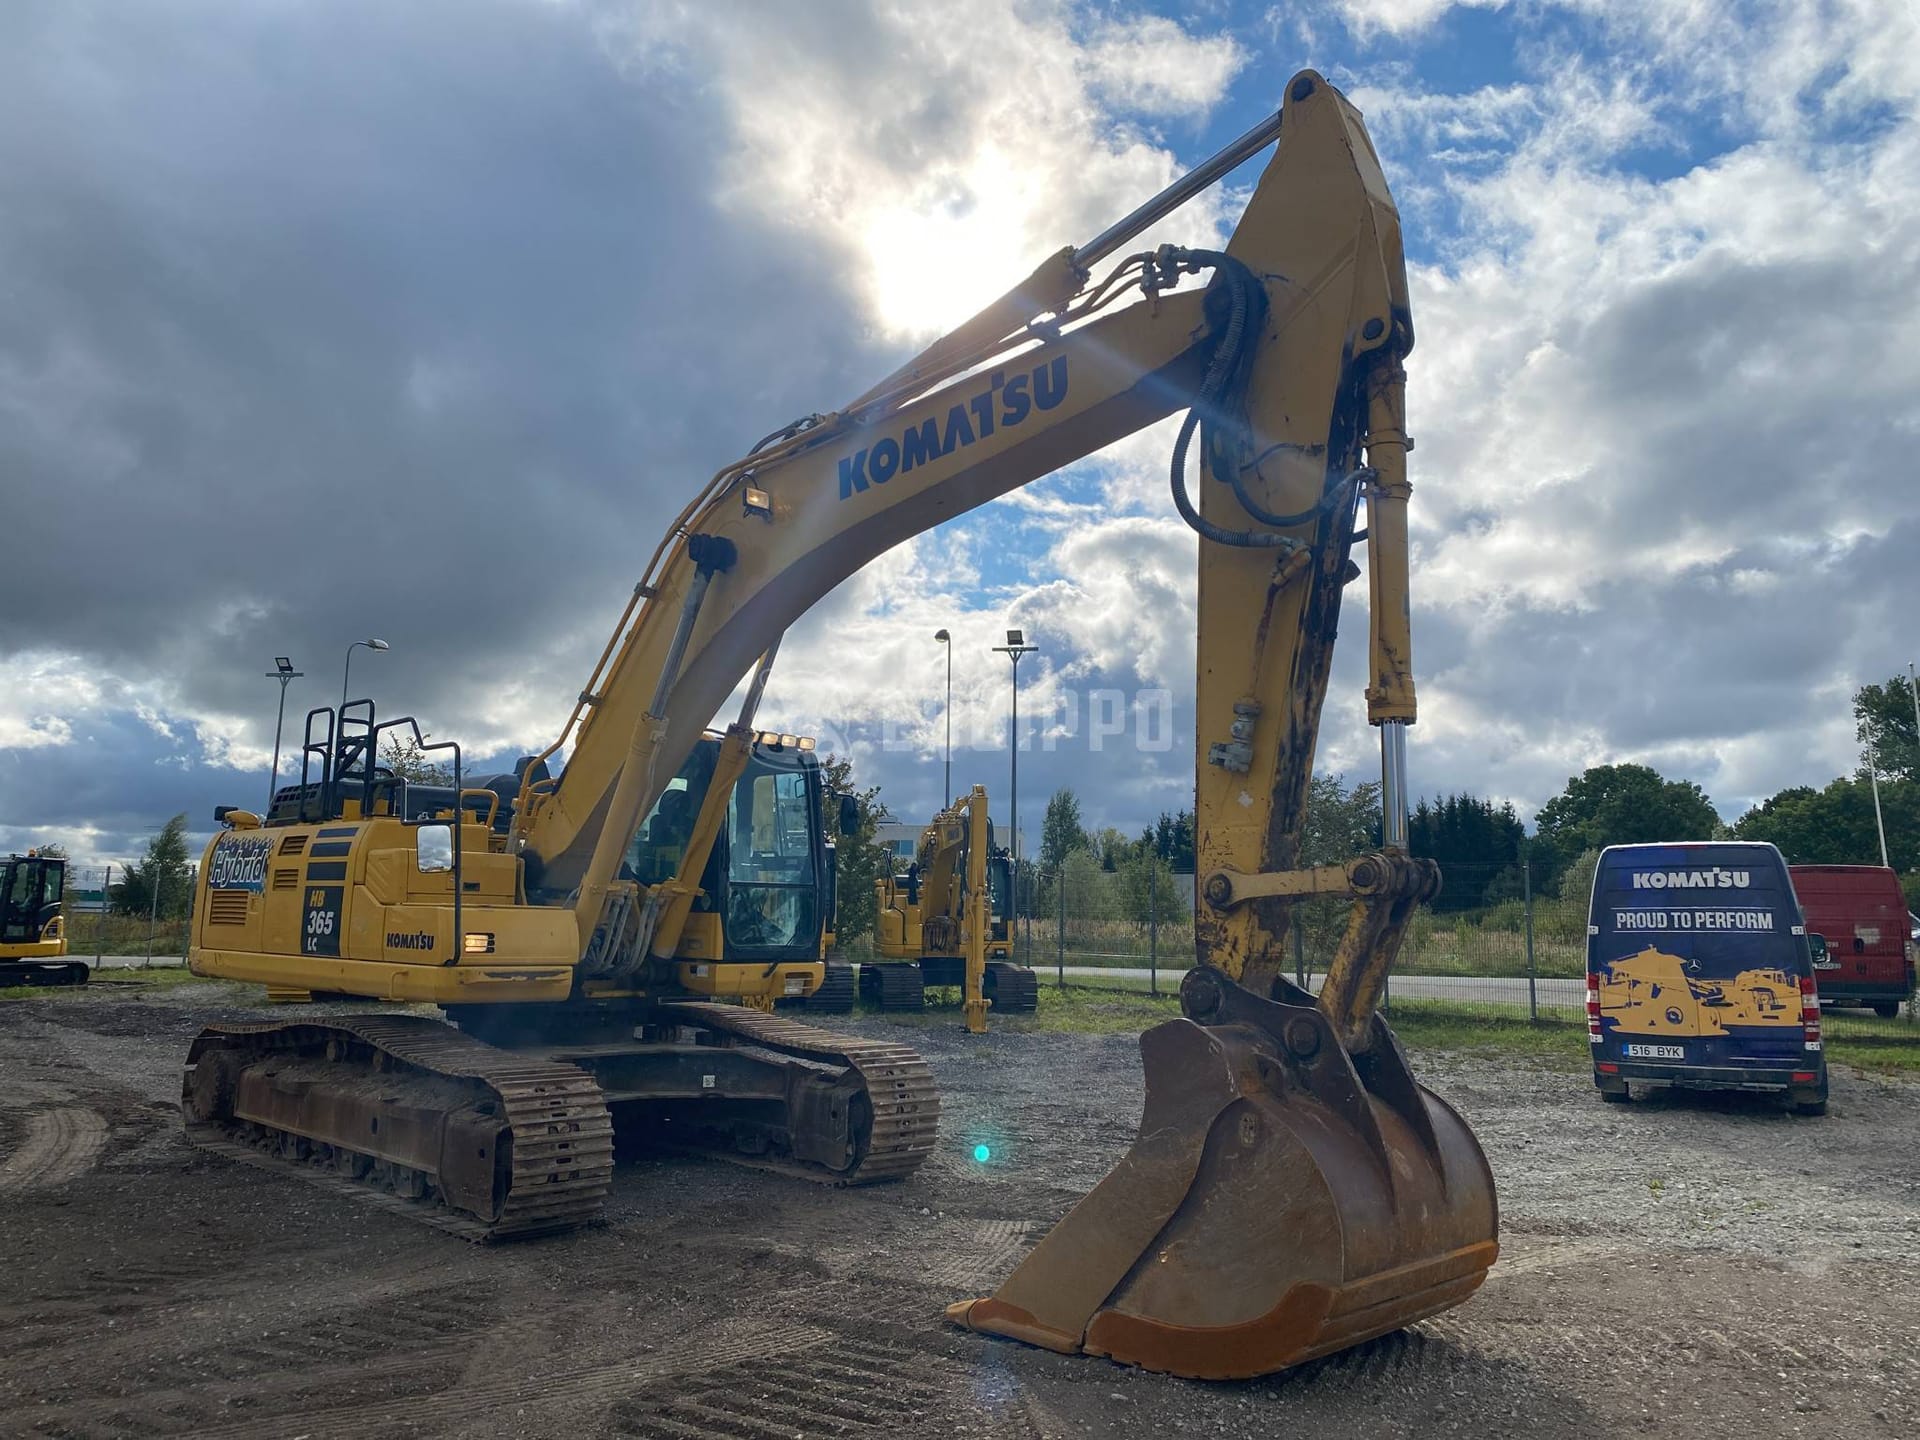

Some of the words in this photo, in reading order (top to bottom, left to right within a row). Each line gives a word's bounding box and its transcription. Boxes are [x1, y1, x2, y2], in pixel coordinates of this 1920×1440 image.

[838, 354, 1068, 500] KOMATSU
[210, 848, 269, 888] Hybrid
[1632, 867, 1750, 888] KOMATSU
[309, 889, 325, 908] HB
[307, 910, 334, 935] 365
[1616, 912, 1668, 929] PROUD
[1671, 912, 1692, 929] TO
[1695, 912, 1773, 930] PERFORM
[307, 937, 318, 952] LC
[386, 930, 434, 951] KOMATSU
[1632, 1045, 1650, 1056] 516
[1657, 1046, 1680, 1057] BYK
